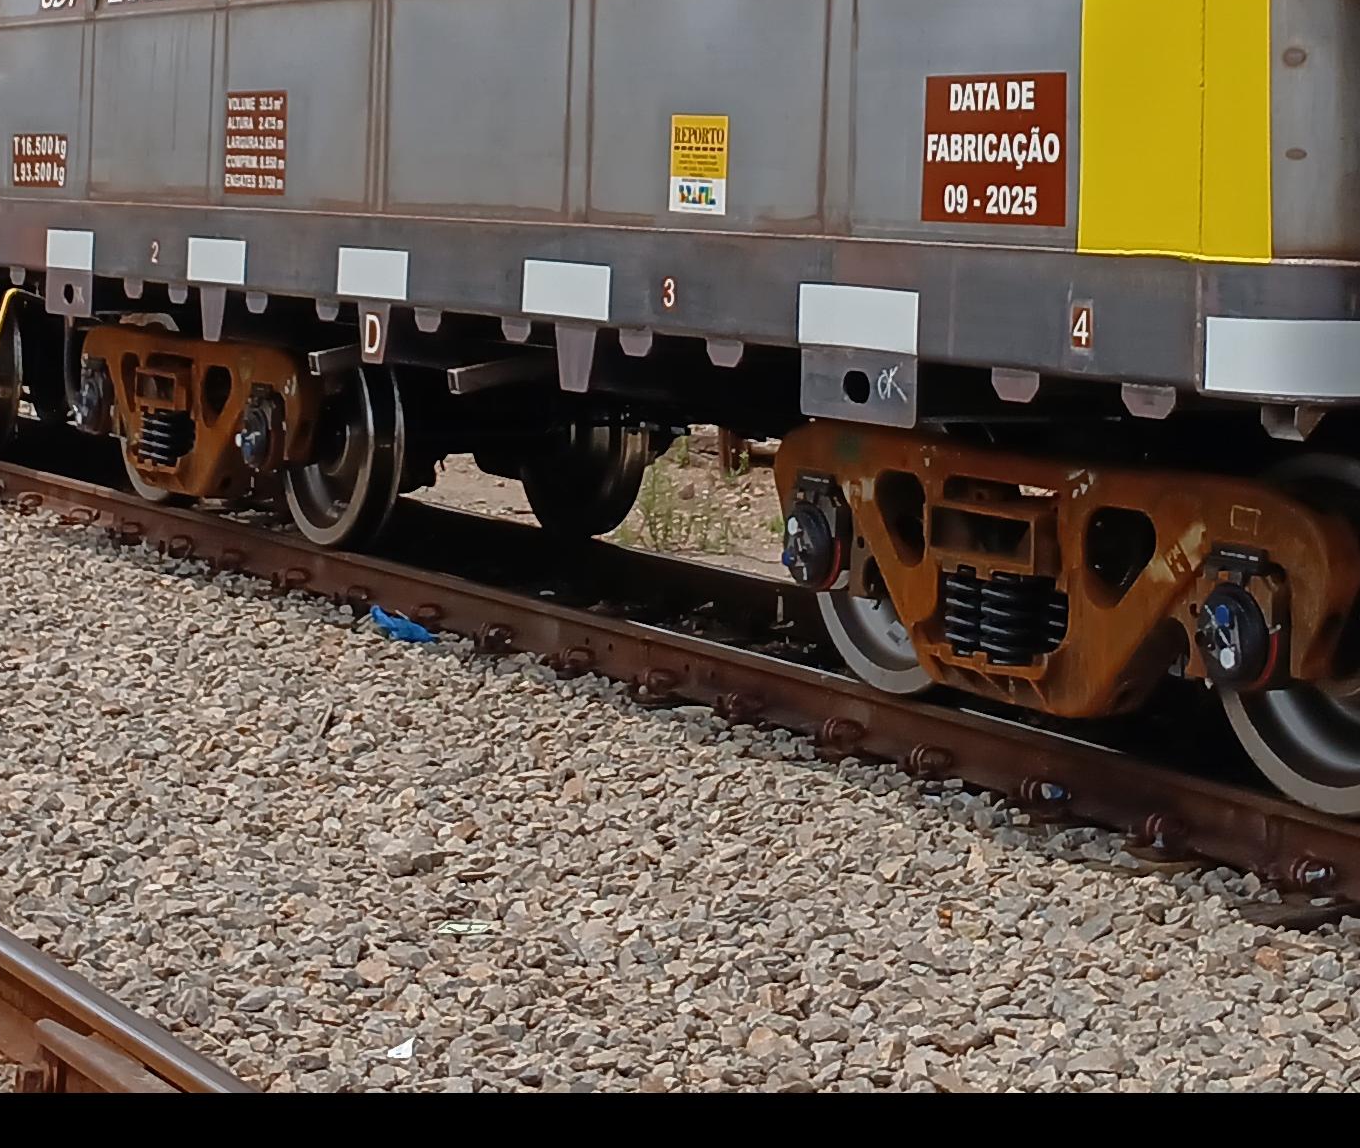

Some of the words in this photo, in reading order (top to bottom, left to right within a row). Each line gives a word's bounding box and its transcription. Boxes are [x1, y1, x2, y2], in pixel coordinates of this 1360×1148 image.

[950, 82, 1001, 112] DATA
[1006, 80, 1035, 110] DE
[674, 126, 724, 145] REPORTO
[927, 126, 1060, 171] FABRICAÇÃO
[944, 185, 968, 214] 09
[985, 185, 1038, 216] 2025
[150, 241, 160, 264] 2
[663, 278, 676, 309] 3
[365, 313, 382, 355] D
[1073, 310, 1089, 346] 4
